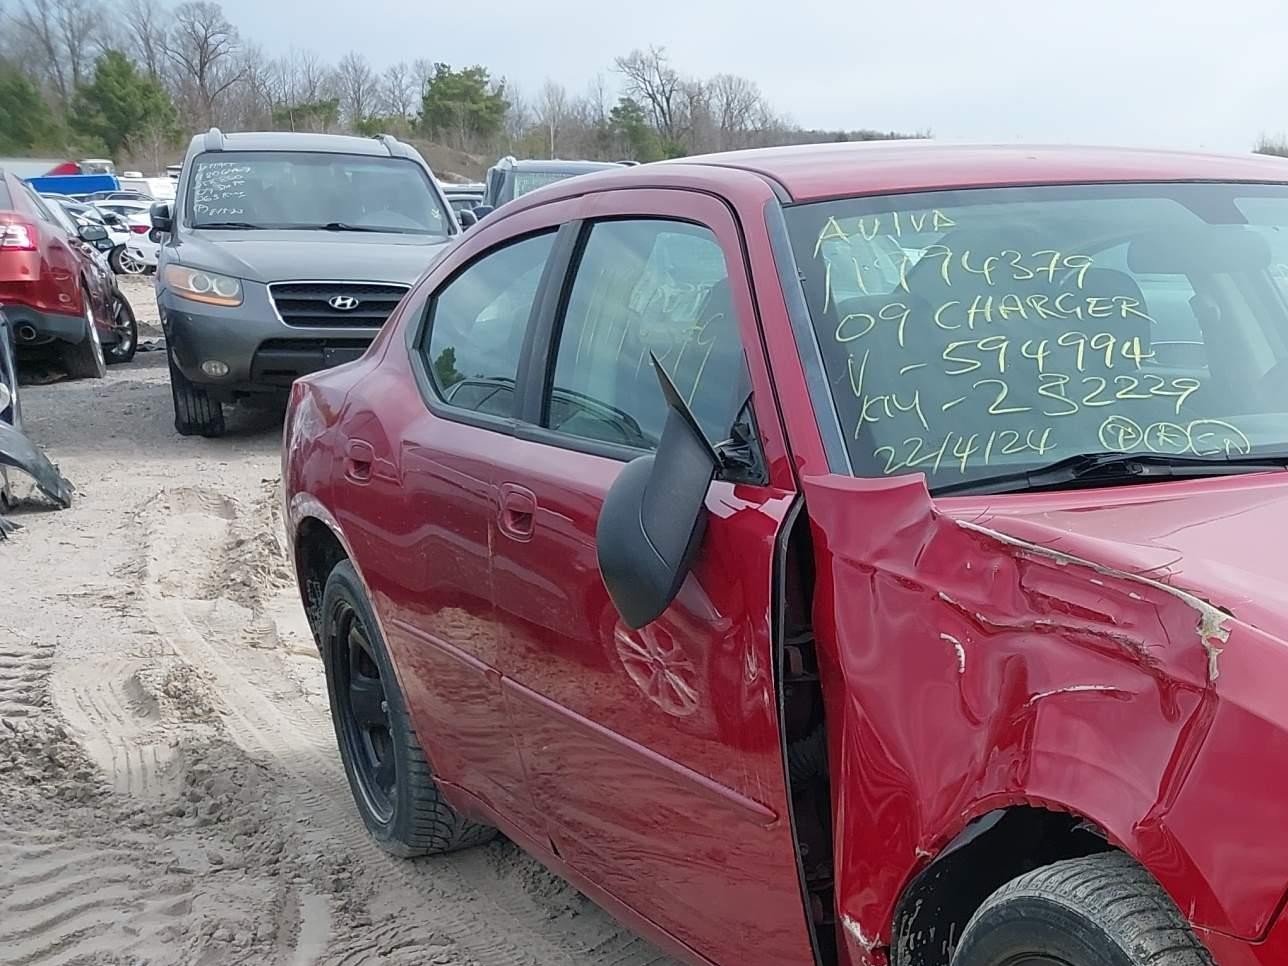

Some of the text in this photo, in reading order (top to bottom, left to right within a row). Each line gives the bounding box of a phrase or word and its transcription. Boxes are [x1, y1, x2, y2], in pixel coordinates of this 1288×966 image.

[835, 292, 1157, 347] 09 CHARGER
[942, 330, 1156, 376] 594994
